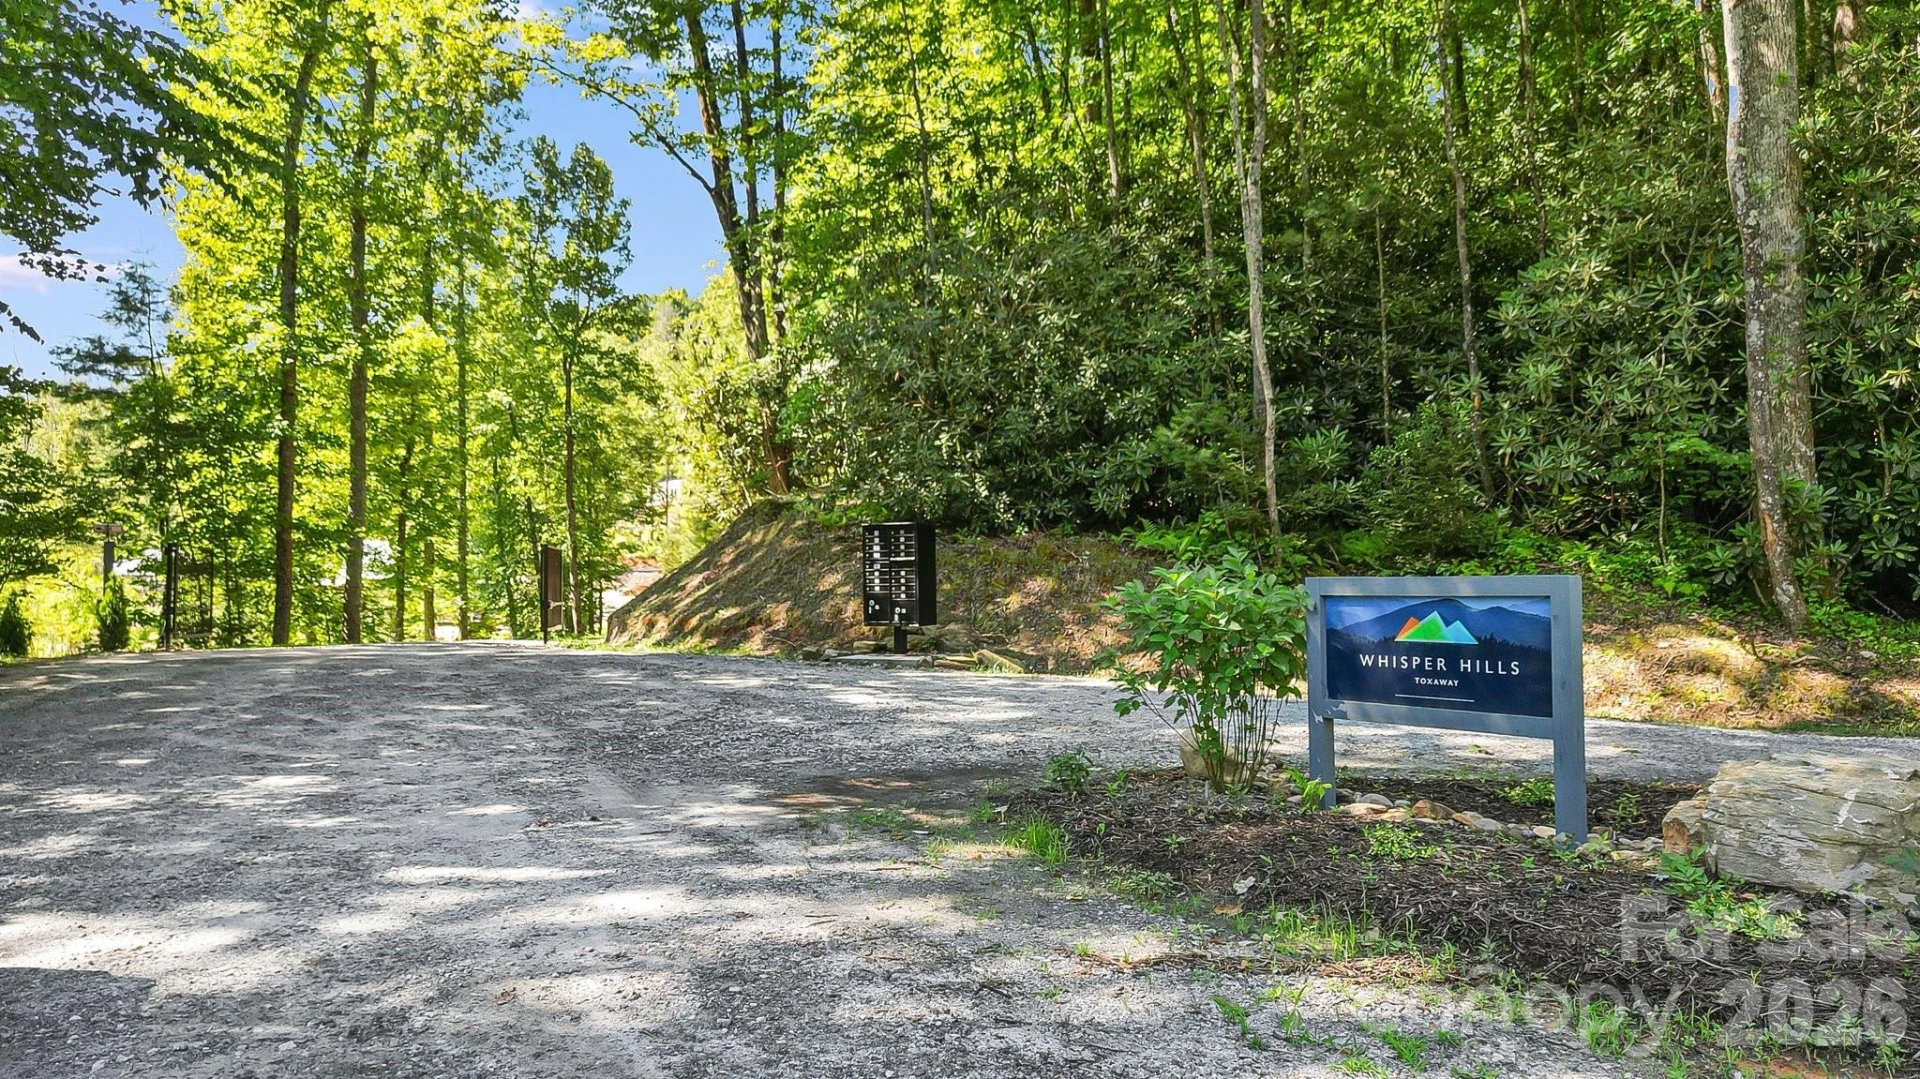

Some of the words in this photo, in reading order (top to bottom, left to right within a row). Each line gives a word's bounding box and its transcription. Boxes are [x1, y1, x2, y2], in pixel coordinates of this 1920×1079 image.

[1359, 653, 1447, 671] WHISPER
[1459, 659, 1520, 675] HILLS
[1414, 676, 1459, 687] TOXAWAY
